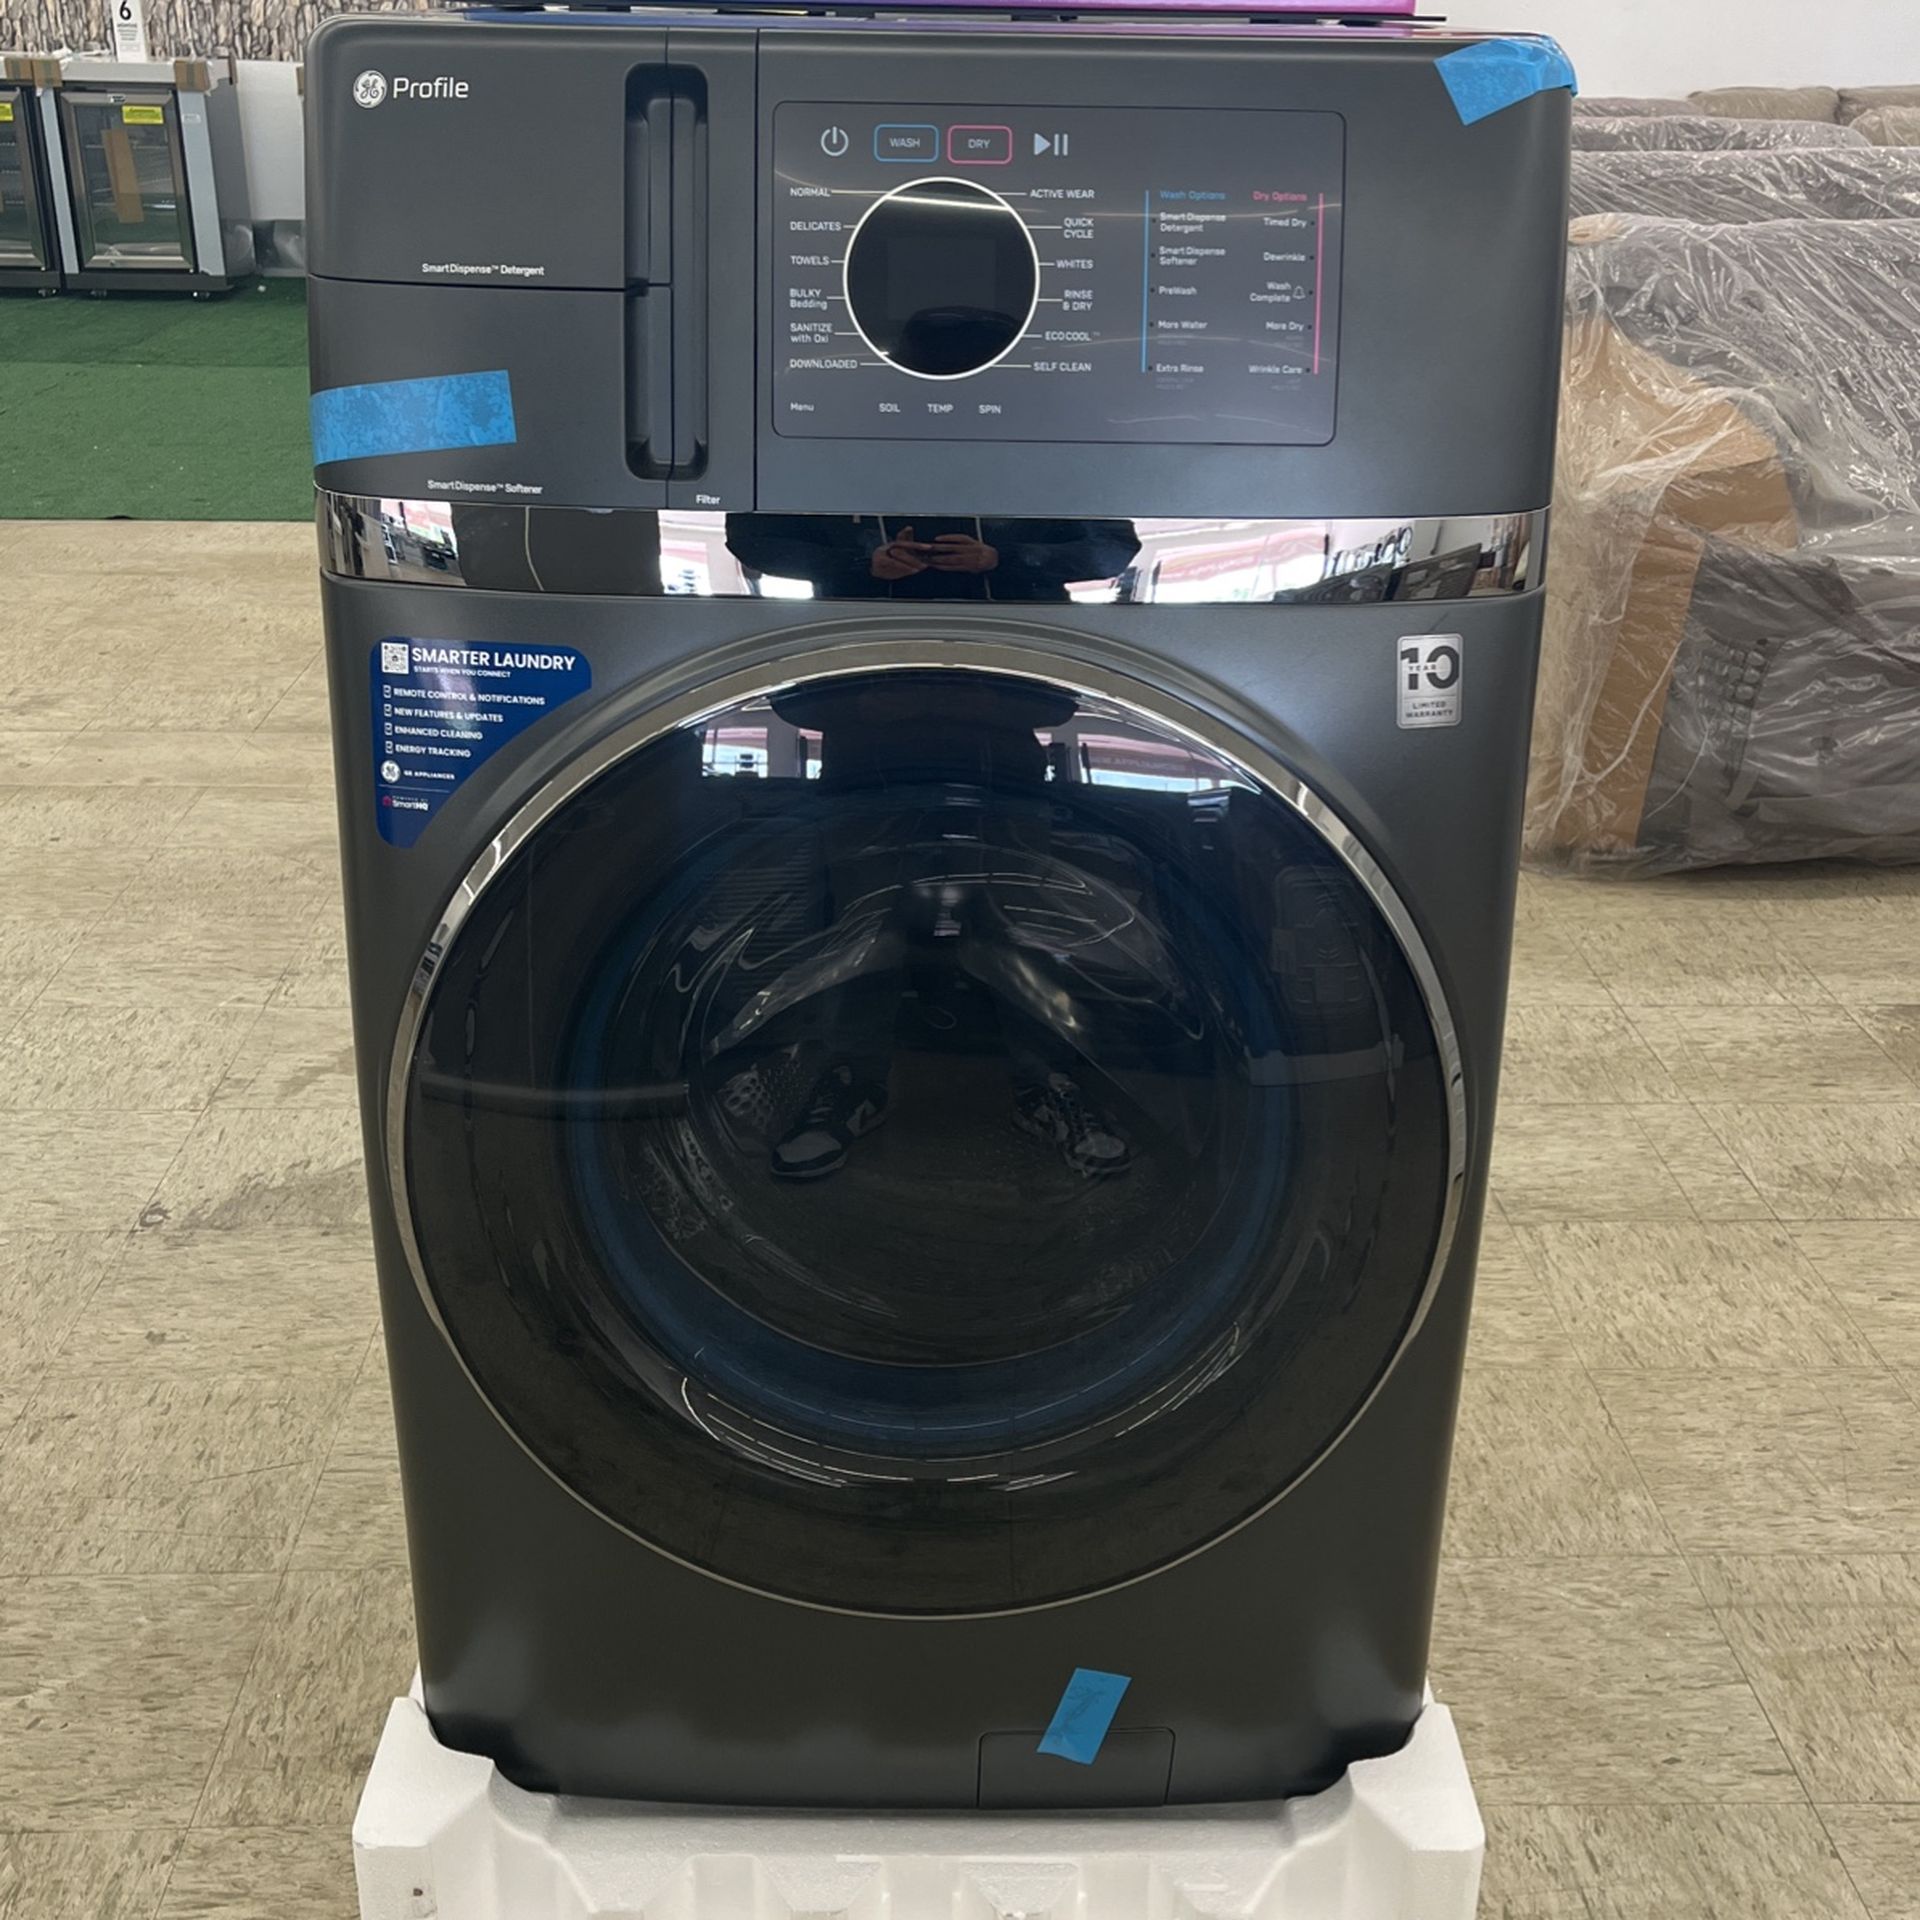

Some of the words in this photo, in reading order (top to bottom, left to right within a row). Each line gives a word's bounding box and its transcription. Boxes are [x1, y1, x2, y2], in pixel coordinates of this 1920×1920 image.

[119, 0, 132, 20] 6
[393, 76, 469, 99] Profile
[889, 137, 921, 148] WASH
[968, 138, 991, 150] DRY
[790, 187, 830, 197] NORMAL
[1029, 189, 1064, 199] ACTIVE
[1066, 189, 1095, 199] WEAR
[1160, 191, 1186, 199] Wash
[1189, 191, 1226, 201] Options
[1253, 191, 1269, 202] Dry
[1272, 192, 1308, 203] Options
[790, 222, 841, 231] DELICATES
[1064, 217, 1094, 228] QUICK
[1263, 218, 1290, 227] Timed
[1291, 218, 1307, 229] Dry
[1160, 223, 1204, 234] Detergent
[1064, 229, 1094, 239] CYCLE
[790, 256, 829, 266] TOWELS
[1159, 257, 1198, 266] Softener
[1263, 252, 1306, 262] Dewrinkle
[1056, 259, 1094, 269] WHITES
[500, 264, 545, 277] Detergent
[1158, 286, 1197, 296] PreWash
[1266, 282, 1291, 291] Wash
[790, 288, 821, 299] BULKY
[1064, 289, 1093, 300] RINSE
[1250, 293, 1290, 304] Complete
[790, 299, 828, 311] Bedding
[1062, 301, 1071, 311] &
[1072, 301, 1093, 311] DRY
[790, 323, 832, 333] SANITIZE
[1158, 320, 1179, 329] More
[1181, 320, 1208, 330] Water
[1265, 321, 1287, 331] More
[1289, 321, 1304, 332] Dry
[790, 333, 812, 343] with
[814, 333, 829, 343] Oxi
[790, 359, 858, 370] DOWNLOADED
[1033, 362, 1057, 372] SELF
[1059, 362, 1092, 372] CLEAN
[1156, 364, 1178, 373] Extra
[1180, 364, 1205, 373] Rinse
[1248, 365, 1279, 374] Wrinkle
[1282, 366, 1303, 375] Care
[790, 402, 814, 412] Menu
[879, 403, 900, 413] SOIL
[928, 403, 953, 413] TEMP
[979, 404, 1002, 414] SPIN
[504, 482, 543, 495] Softener
[696, 494, 720, 505] Filter
[411, 647, 490, 667] SMARTER
[494, 651, 576, 671] LAUNDRY
[1400, 645, 1460, 690] 10
[462, 669, 476, 677] YOU
[476, 669, 511, 678] CONNECT
[393, 687, 426, 698] REMOTE
[427, 690, 468, 701] CONTROL
[469, 692, 476, 701] &
[478, 693, 546, 706] NOTIFICATIONS
[1412, 701, 1446, 709] LIMITED
[394, 707, 413, 717] NEW
[413, 708, 455, 720] FEATURES
[456, 711, 463, 720] &
[464, 712, 504, 723] UPDATES
[1405, 709, 1453, 718] WARRANTY
[394, 725, 440, 737] ENHANCED
[440, 728, 483, 740] CLEANING
[395, 744, 428, 755] ENERGY
[428, 746, 471, 758] TRACKING
